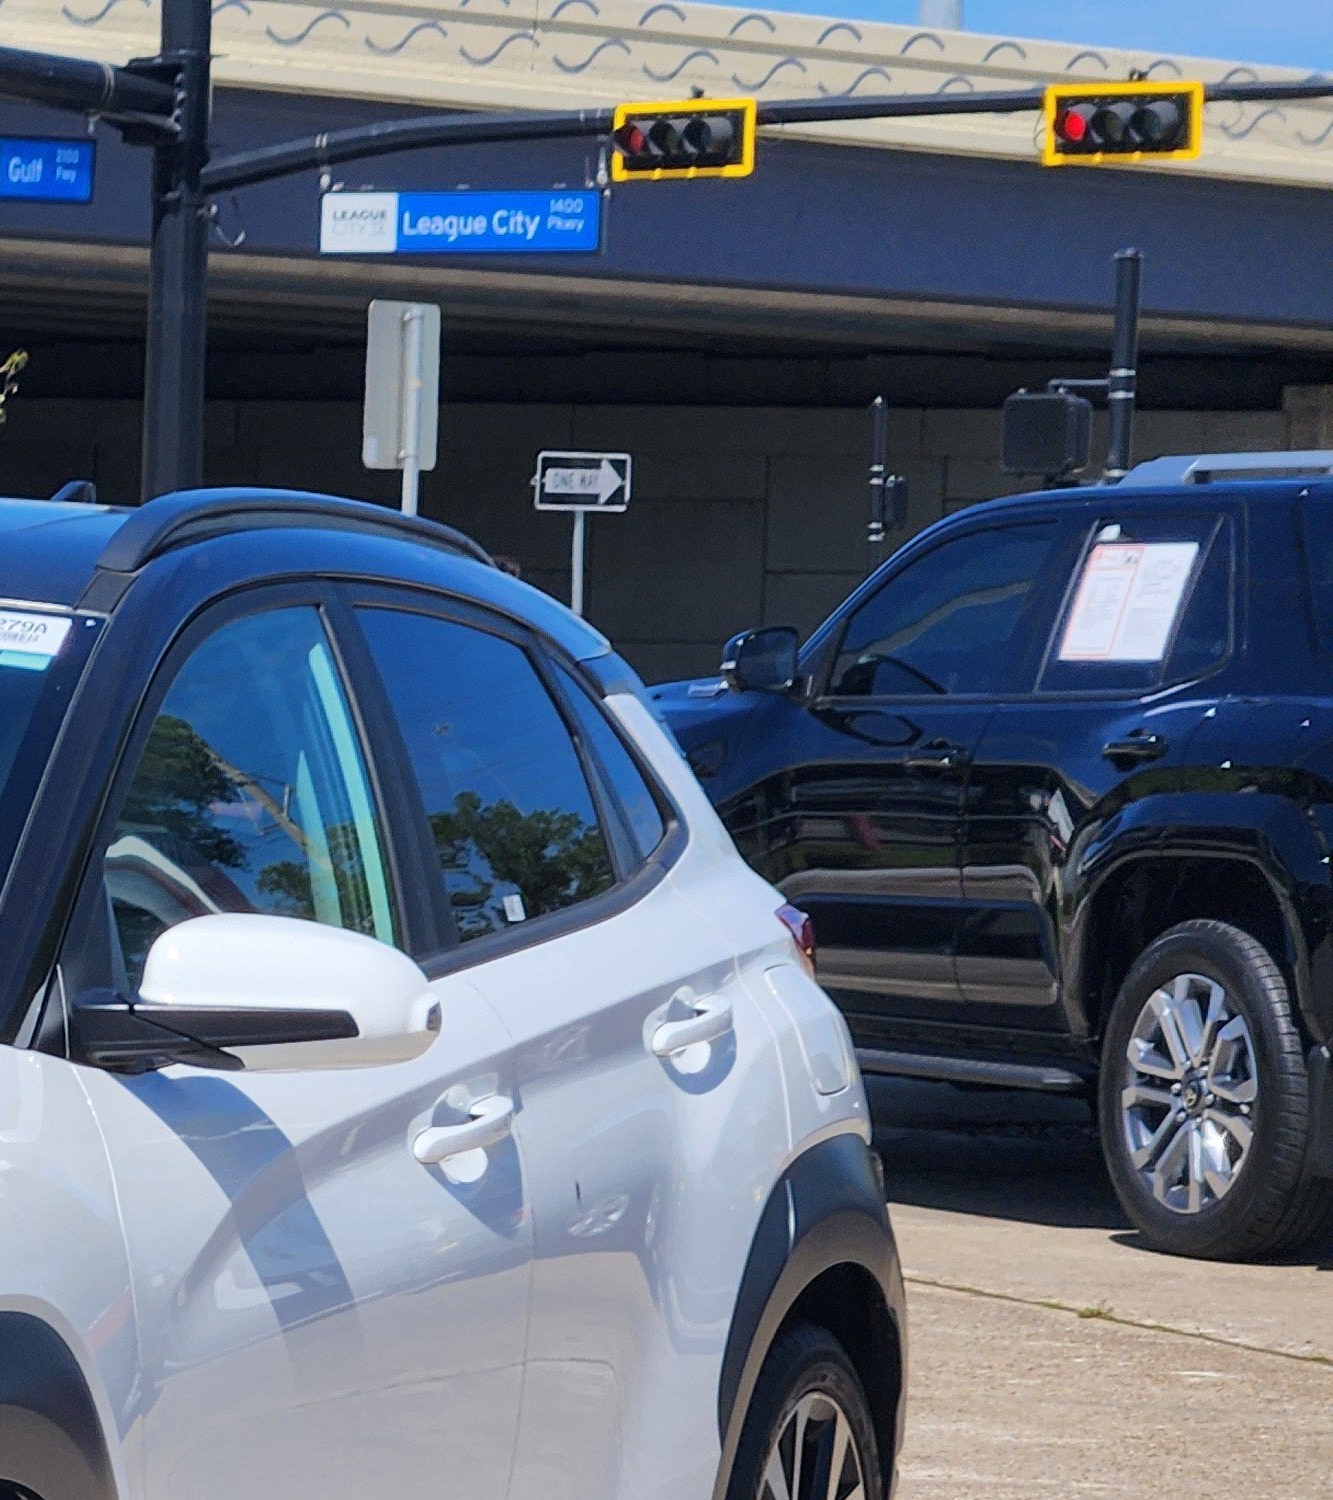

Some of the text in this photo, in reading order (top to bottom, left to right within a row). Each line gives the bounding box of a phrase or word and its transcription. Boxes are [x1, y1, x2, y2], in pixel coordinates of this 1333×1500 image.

[7, 156, 44, 183] Gulf
[332, 209, 388, 221] LEAGUE
[550, 198, 583, 213] 1400
[402, 209, 541, 242] League City
